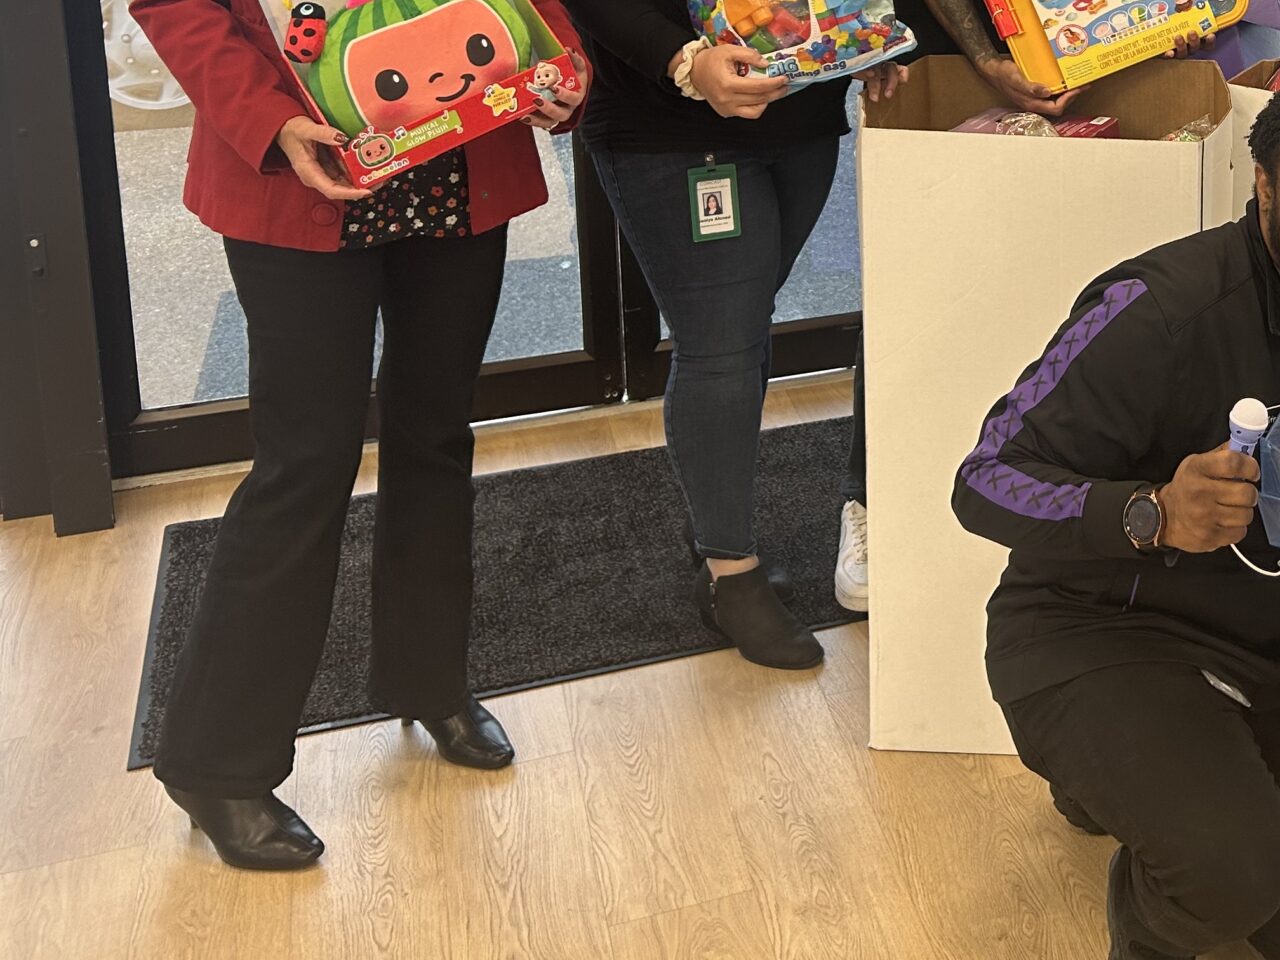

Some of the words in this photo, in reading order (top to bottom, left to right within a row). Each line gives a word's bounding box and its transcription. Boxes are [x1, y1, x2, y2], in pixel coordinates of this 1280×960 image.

[1102, 36, 1111, 45] 10
[1096, 46, 1124, 62] COMPOUND
[768, 59, 799, 77] BIG
[823, 60, 847, 72] Bag
[406, 132, 427, 148] GLOW
[426, 123, 449, 140] PLUSH
[409, 120, 439, 137] MUSICAL
